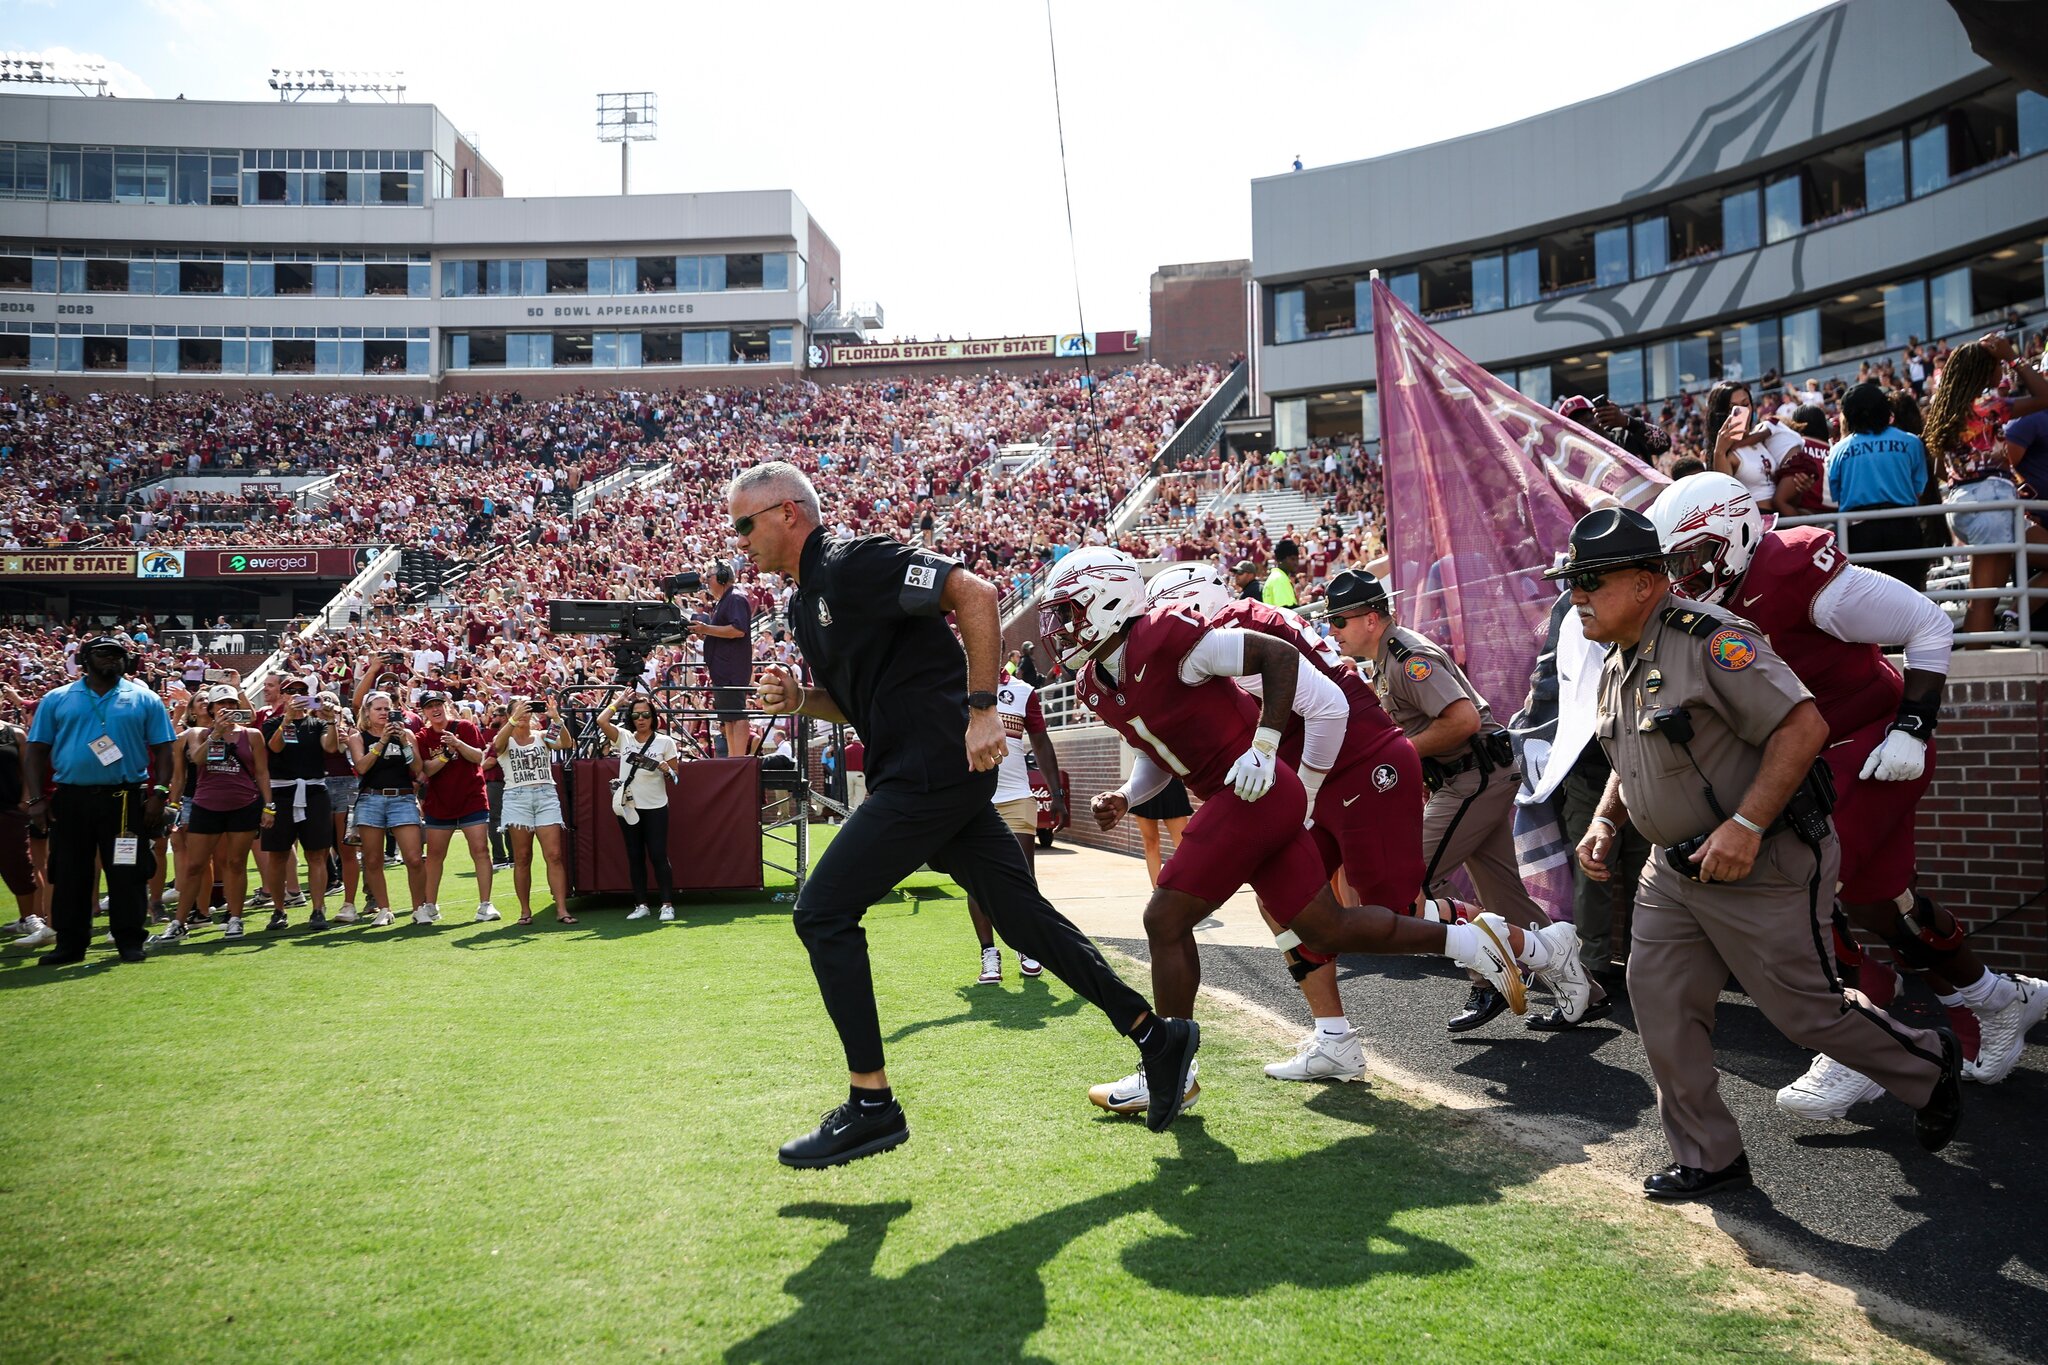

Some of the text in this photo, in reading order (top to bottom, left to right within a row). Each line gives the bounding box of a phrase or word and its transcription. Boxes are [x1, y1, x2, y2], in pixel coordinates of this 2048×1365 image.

[0, 303, 94, 315] 2014 2023
[527, 304, 695, 317] 50 BOWL APPEARANCES
[838, 340, 1048, 361] FLORIDA STATE KENT STATE
[1841, 440, 1909, 461] SENTRY
[22, 557, 69, 571] KENT
[73, 557, 128, 571] STATE
[249, 555, 307, 571] everged
[1126, 716, 1191, 777] 1
